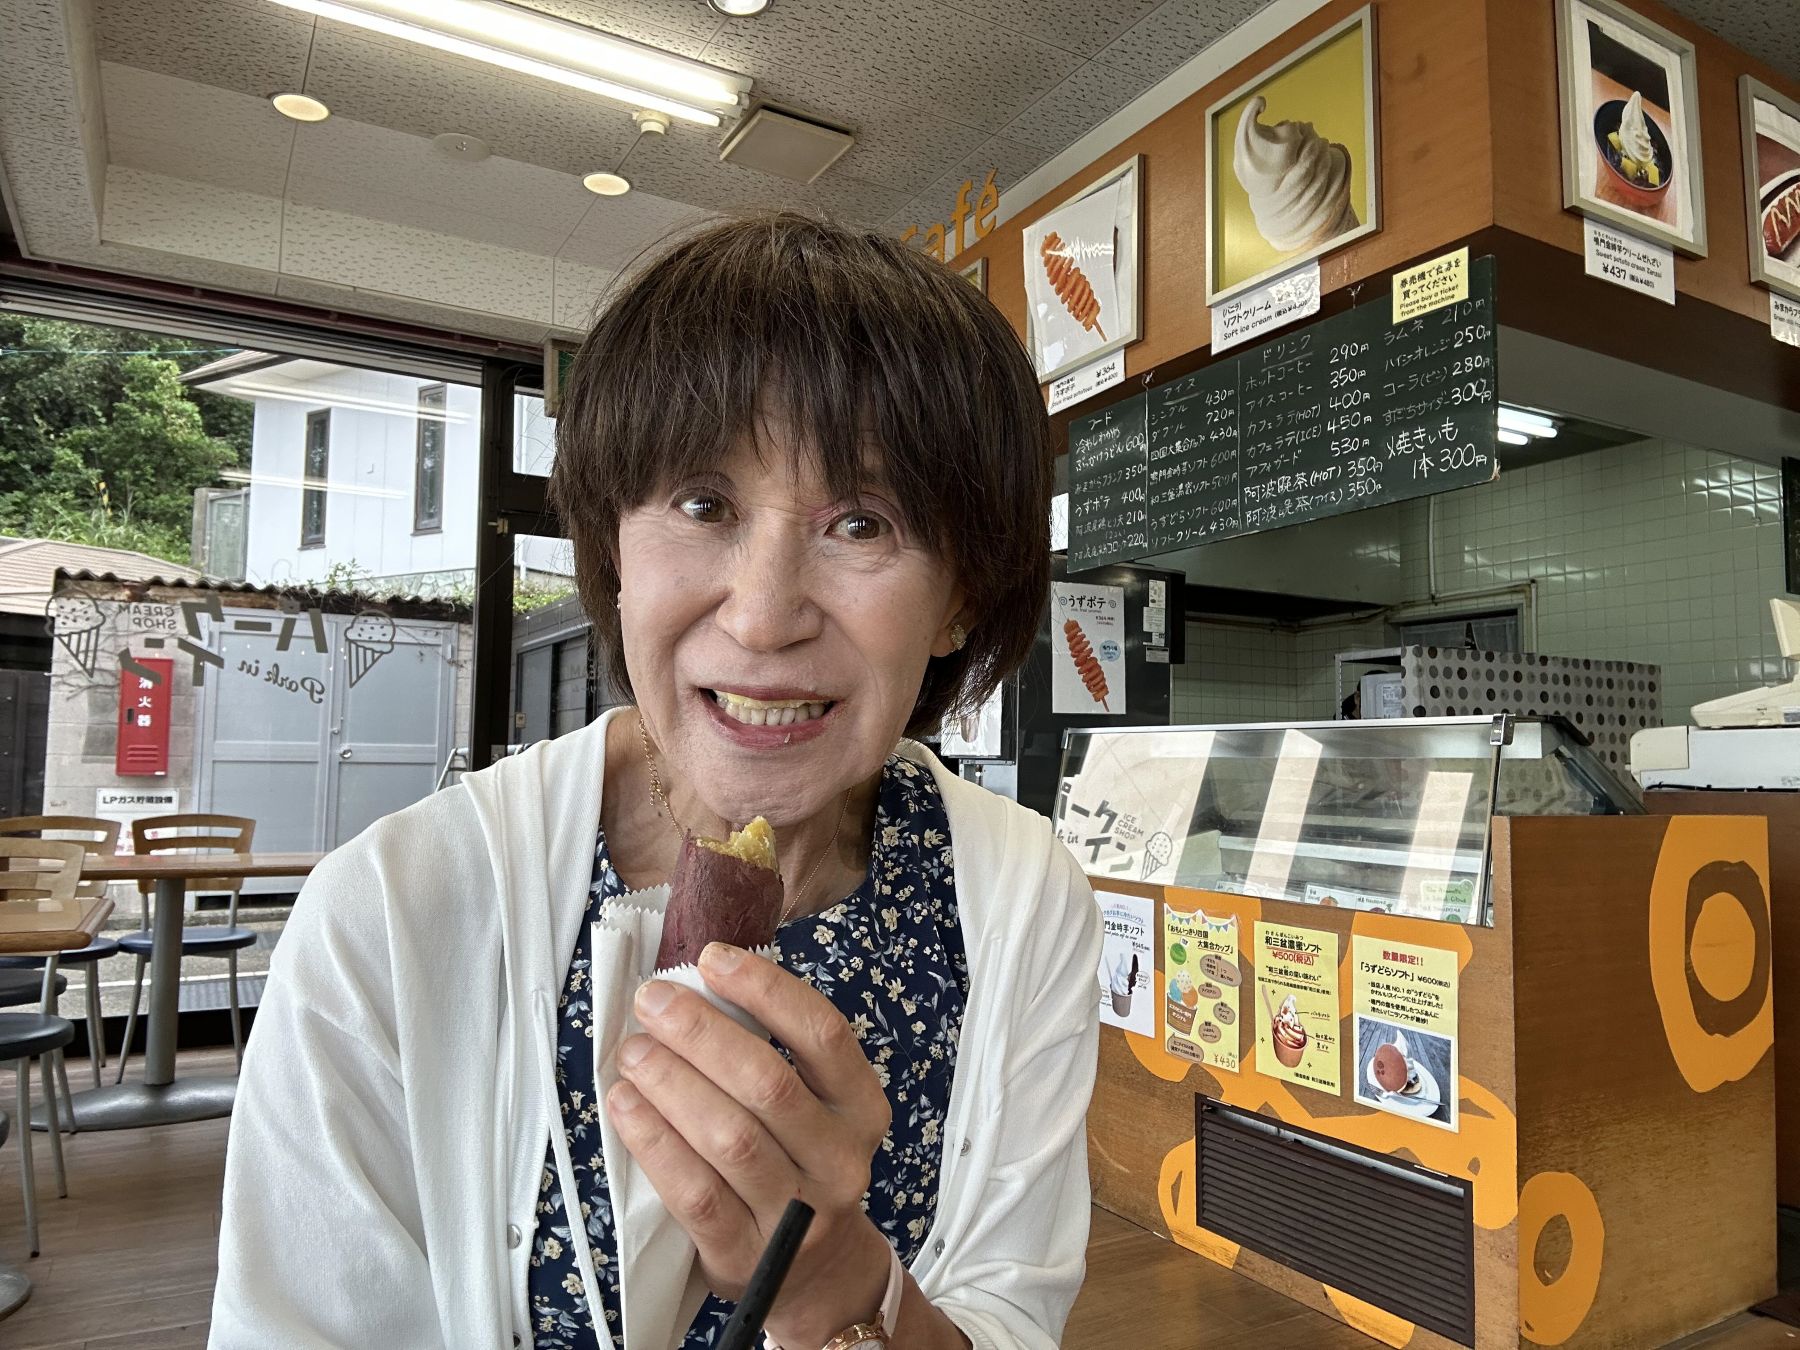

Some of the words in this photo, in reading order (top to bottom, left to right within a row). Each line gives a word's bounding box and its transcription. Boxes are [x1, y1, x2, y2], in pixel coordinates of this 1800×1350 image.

[1596, 249, 1612, 260] Sweet
[1602, 263, 1627, 280] ¥437
[1400, 298, 1420, 309] Please
[1420, 293, 1432, 303] buy
[1440, 284, 1459, 296] ticket
[1402, 273, 1457, 301] 買ってください
[1224, 301, 1271, 328] ソフトクリーム
[1401, 307, 1415, 317] from
[1428, 294, 1455, 306] machine
[1223, 328, 1238, 340] Soft
[1240, 324, 1249, 333] ice
[1251, 315, 1272, 327] cream
[1384, 320, 1423, 346] ラムネ
[1441, 299, 1485, 324] 210円
[1454, 325, 1491, 348] 250円
[1263, 334, 1311, 363] ドリンク
[1246, 360, 1311, 392] ホットコーヒー
[1329, 343, 1369, 363] 290円
[1452, 355, 1490, 376] 280円
[1163, 378, 1195, 399] アイス
[1246, 383, 1312, 413] アイスコーヒー
[1330, 367, 1366, 388] 350円
[1151, 405, 1188, 425] シングル
[1205, 389, 1235, 406] 430円
[1382, 390, 1451, 425] すだちサイダー
[1451, 378, 1491, 405] 300円
[1088, 411, 1113, 430] フード
[1246, 403, 1320, 437] カフェラテ(HOT)
[1329, 389, 1370, 411] 400円
[1152, 421, 1186, 442] ダブル
[1206, 408, 1235, 425] 720円
[1210, 426, 1238, 442] 430円
[1247, 424, 1321, 458] カフェラテ(ICE)
[1327, 412, 1372, 434] 450円
[1331, 437, 1370, 457] 530円
[1386, 416, 1459, 459] 焼きいも
[1210, 450, 1237, 469] 600円
[1348, 456, 1383, 478] 350円
[1413, 452, 1435, 479] 1本
[1440, 443, 1487, 472] 300円
[1211, 472, 1237, 490] 500円
[1347, 477, 1382, 500] 350円
[1075, 495, 1111, 517] うずポテ
[1121, 487, 1146, 504] 400円
[1151, 506, 1208, 531] うずどらソフト
[1211, 499, 1237, 515] 600円
[1127, 533, 1148, 548] 220円
[1152, 525, 1206, 547] ソフトクリーム
[1210, 517, 1239, 533] 430円
[1068, 595, 1106, 608] うずポテ
[1118, 820, 1144, 837] CREAM
[1123, 813, 1136, 823] ICE
[1114, 827, 1136, 840] SHOP
[1104, 921, 1144, 936] 門金時芋ソフト
[1168, 924, 1208, 938] 「おもいっきり四国
[1198, 940, 1233, 954] 大集合カップ」
[1265, 936, 1322, 953] 和三盆濃蜜ソフト
[1272, 951, 1314, 966] ¥500(税込)
[1383, 950, 1423, 966] 数量限定!!
[1360, 962, 1414, 981] 「うずどらソフト」
[1214, 1054, 1235, 1068] ¥430
